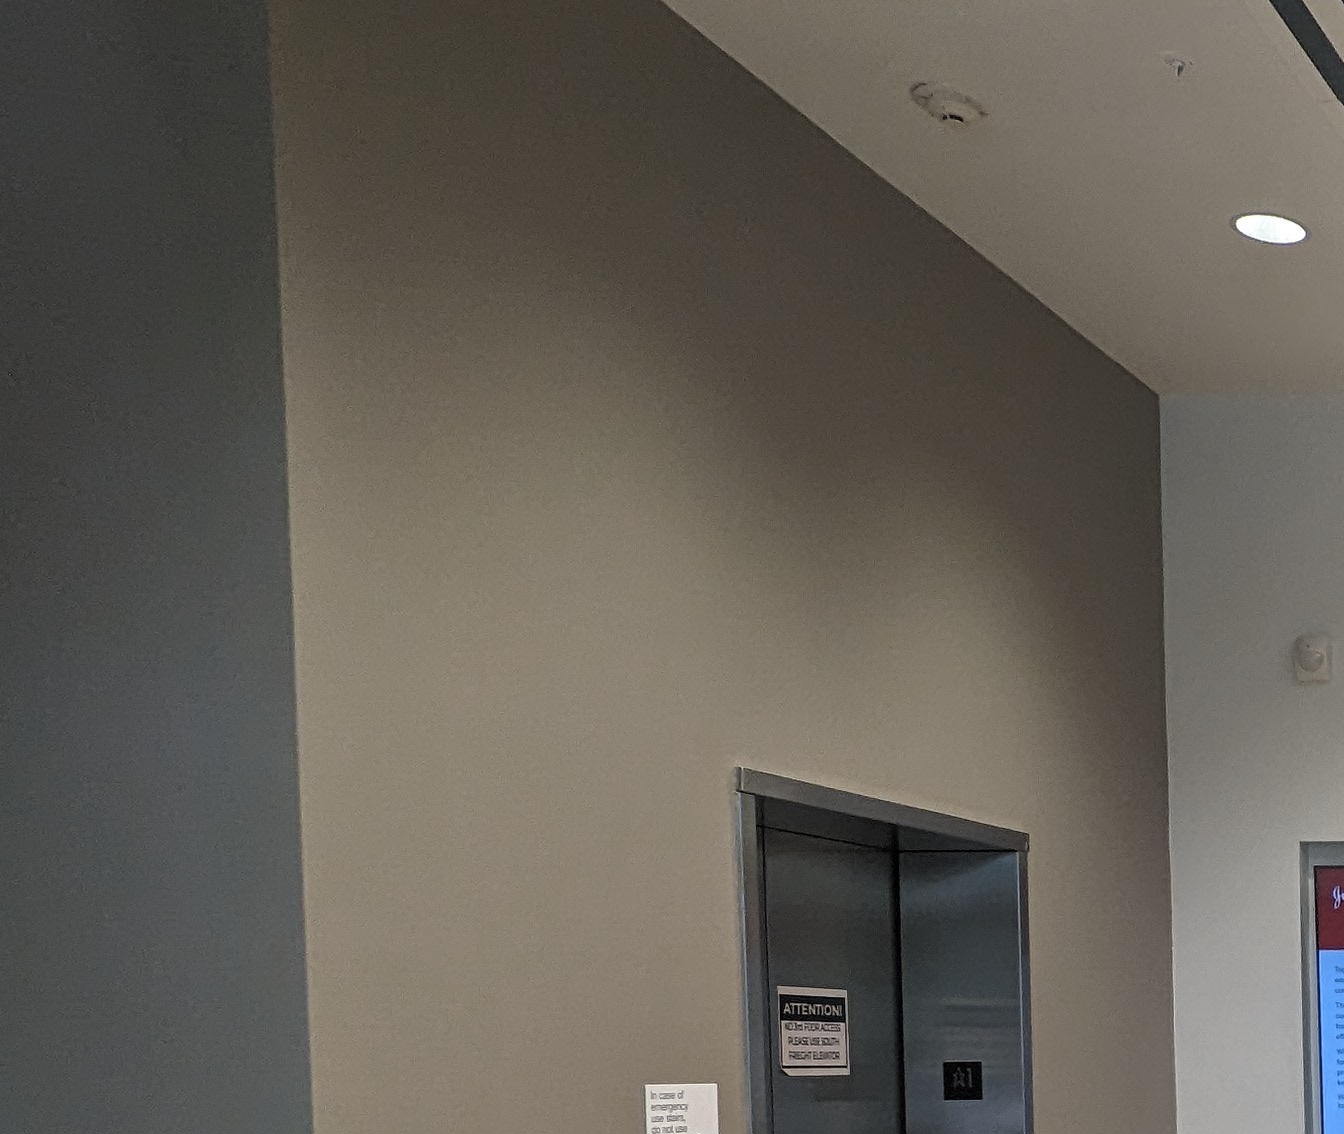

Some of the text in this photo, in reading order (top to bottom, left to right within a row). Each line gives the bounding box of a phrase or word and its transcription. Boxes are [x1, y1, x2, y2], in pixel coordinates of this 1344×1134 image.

[783, 1002, 843, 1017] ATTENTION!
[650, 1091, 657, 1100] In
[651, 1103, 688, 1113] emergency
[651, 1115, 664, 1123] use
[662, 1126, 674, 1134] not
